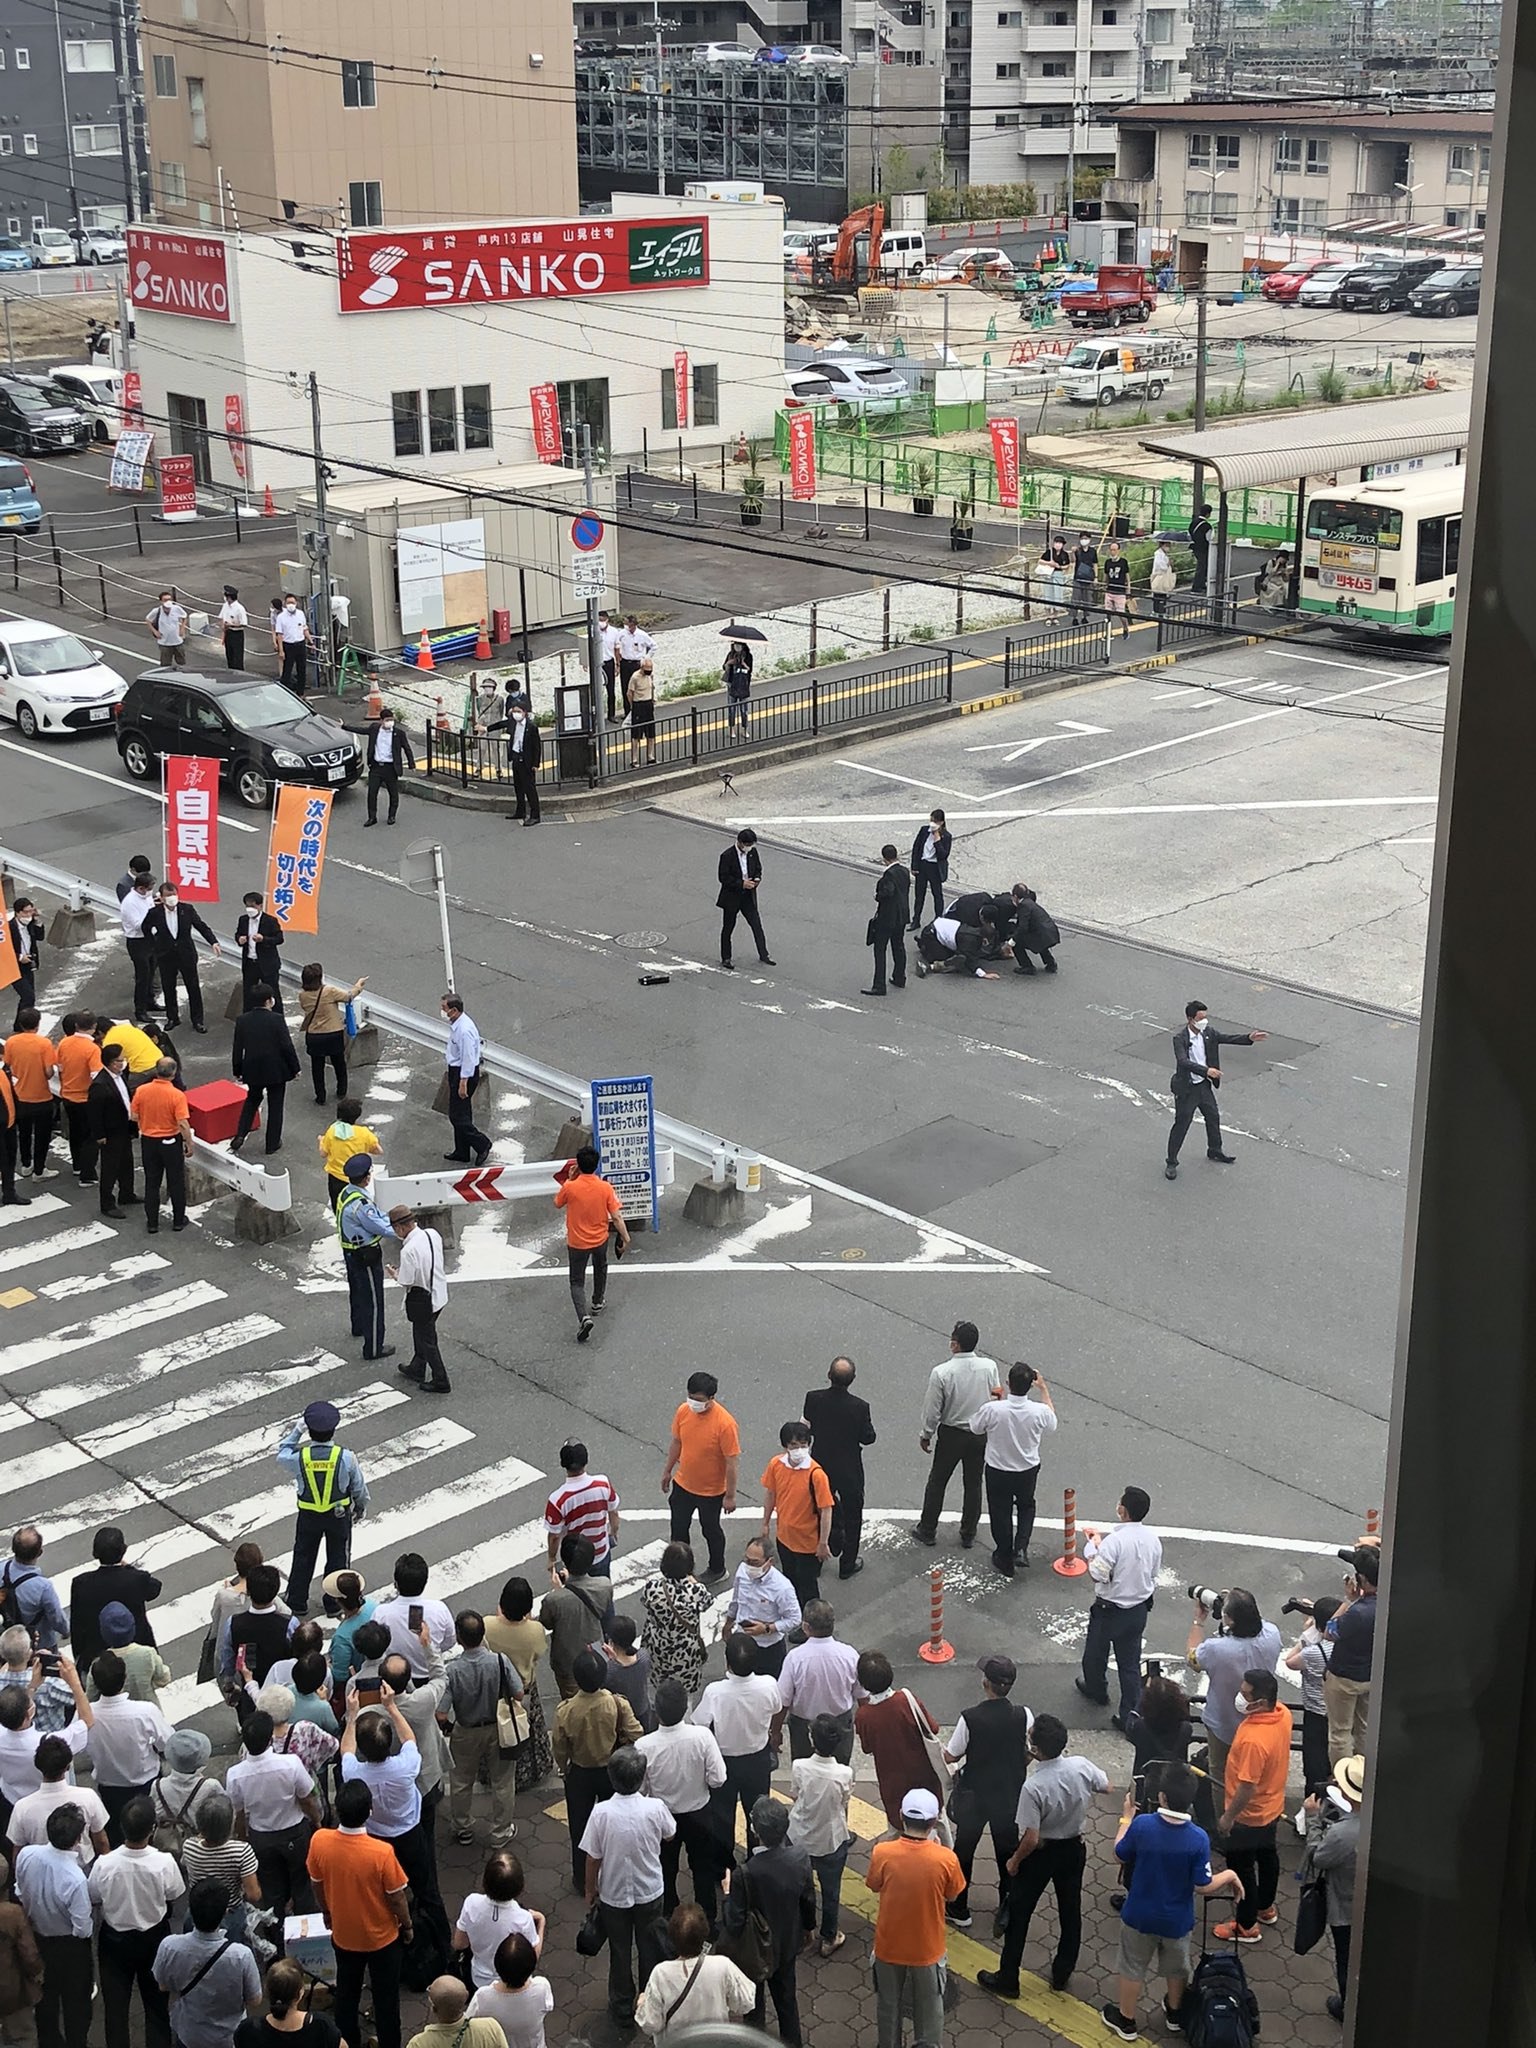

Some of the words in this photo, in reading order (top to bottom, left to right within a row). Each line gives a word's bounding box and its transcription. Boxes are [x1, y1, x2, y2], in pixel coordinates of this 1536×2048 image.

[632, 230, 703, 268] エイブル
[424, 252, 604, 301] SANKO
[653, 266, 701, 278] ネットワーク店
[151, 274, 227, 313] SANKO
[163, 492, 195, 503] SANKO
[1327, 530, 1376, 545] ノンステップバス
[1336, 574, 1373, 591] ツキムラ
[176, 788, 211, 889] 自民党
[298, 799, 328, 895] 次の時代を
[274, 852, 296, 922] 切り拓く
[598, 1099, 648, 1116] 駅前広場を大きくする
[599, 1115, 648, 1131] 工事を行っています
